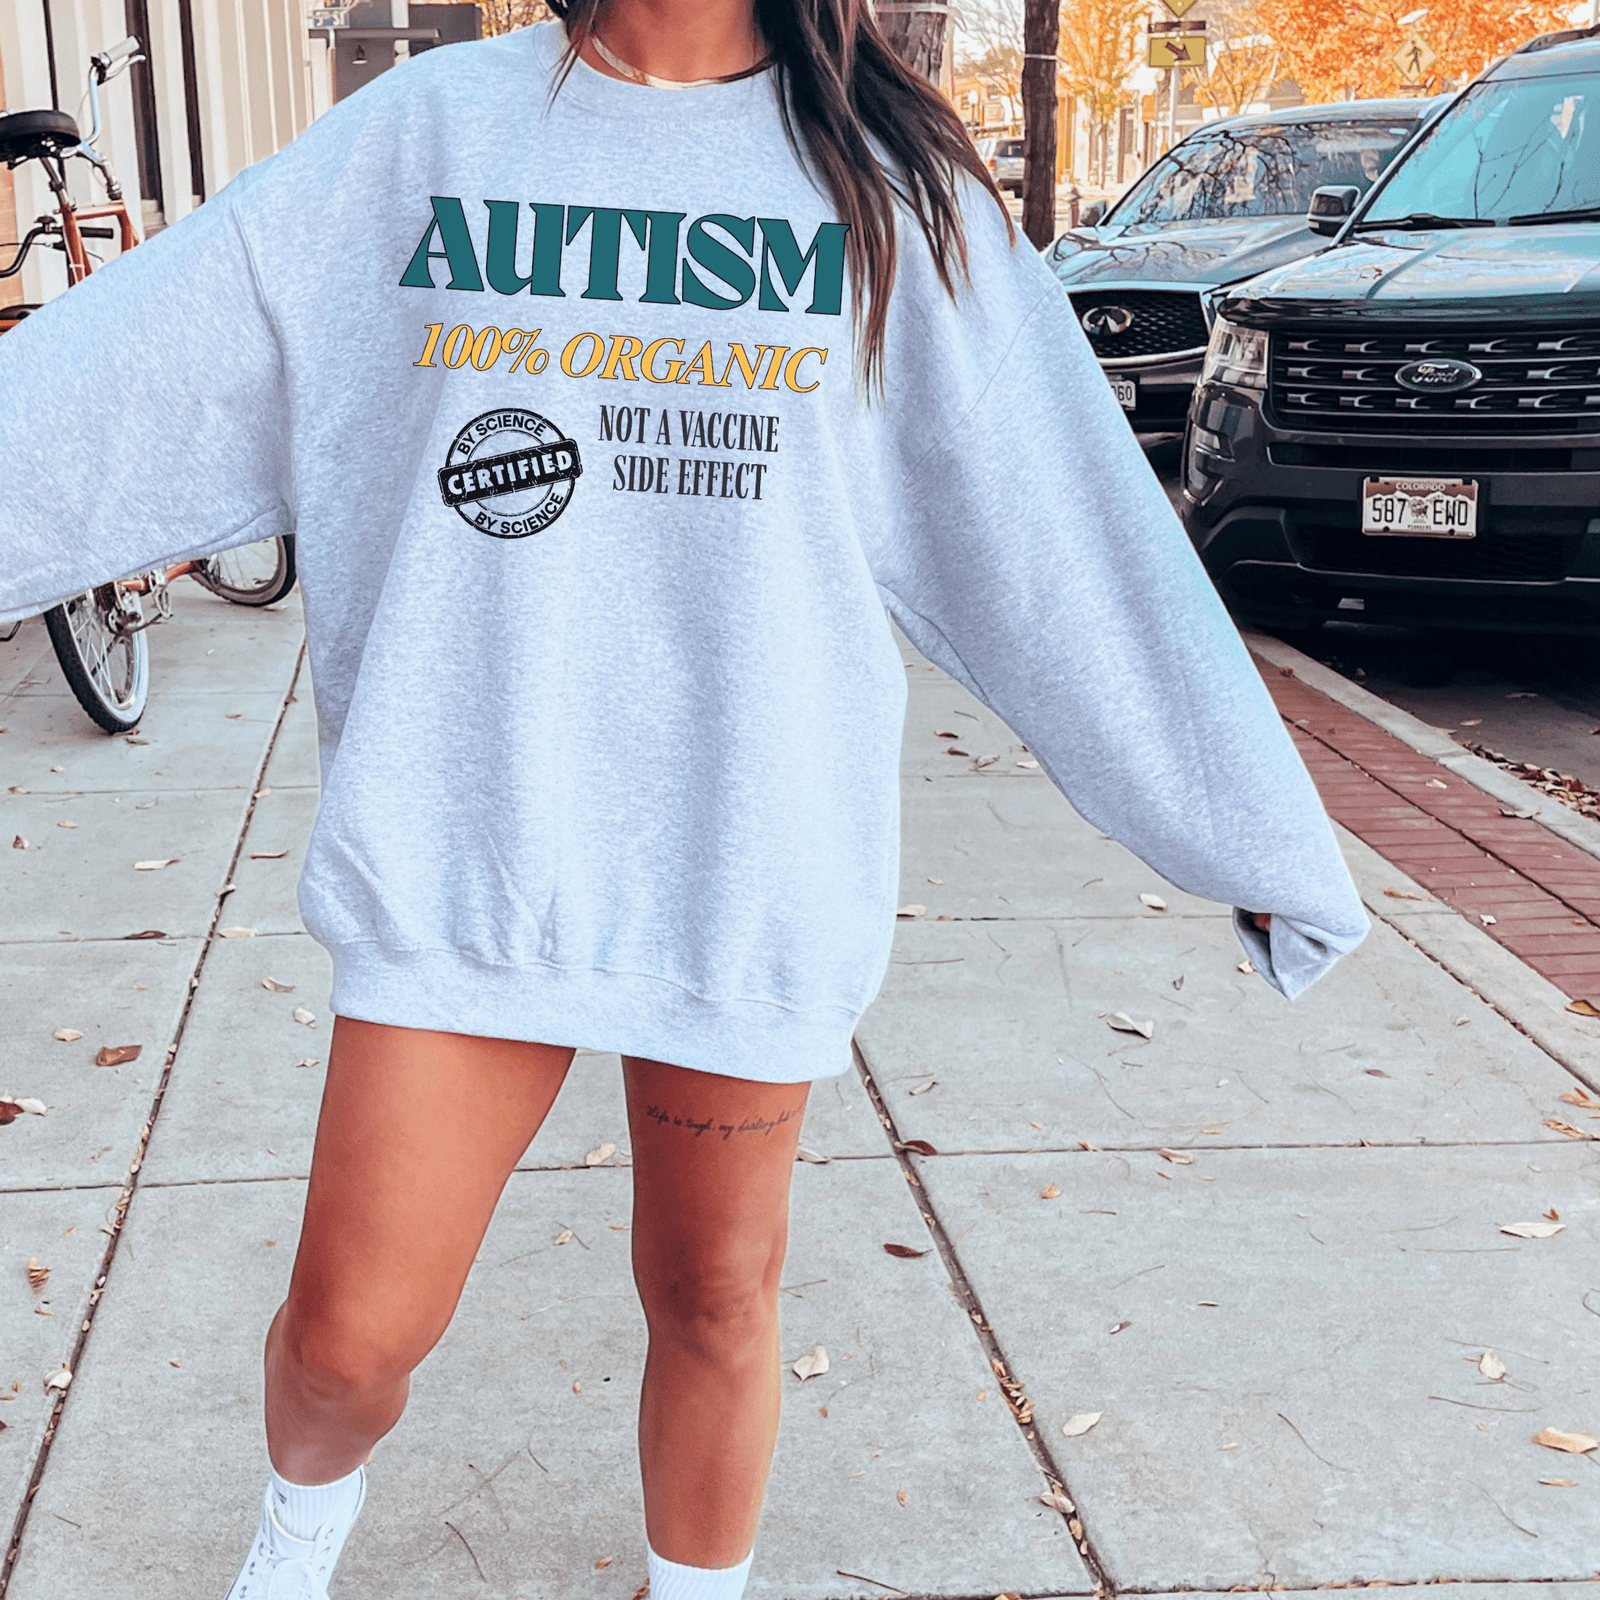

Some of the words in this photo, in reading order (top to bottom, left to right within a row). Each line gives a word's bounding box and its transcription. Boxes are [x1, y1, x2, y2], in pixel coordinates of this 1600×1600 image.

[399, 196, 851, 315] AUTISM
[413, 323, 550, 375] 100%
[560, 332, 829, 394] ORGANIC
[1411, 362, 1460, 383] Ford
[456, 431, 476, 456] BY
[475, 414, 547, 437] SCIENCE
[598, 405, 651, 444] NOT
[655, 408, 672, 446] A
[678, 410, 780, 453] VACCINE
[447, 450, 573, 495] CERTIFIED
[612, 454, 670, 494] SIDE
[676, 458, 768, 500] EFFECT
[1395, 481, 1446, 491] COLORADO
[474, 511, 498, 530] BY
[500, 492, 564, 534] SCIENCE
[1371, 497, 1407, 524] 587
